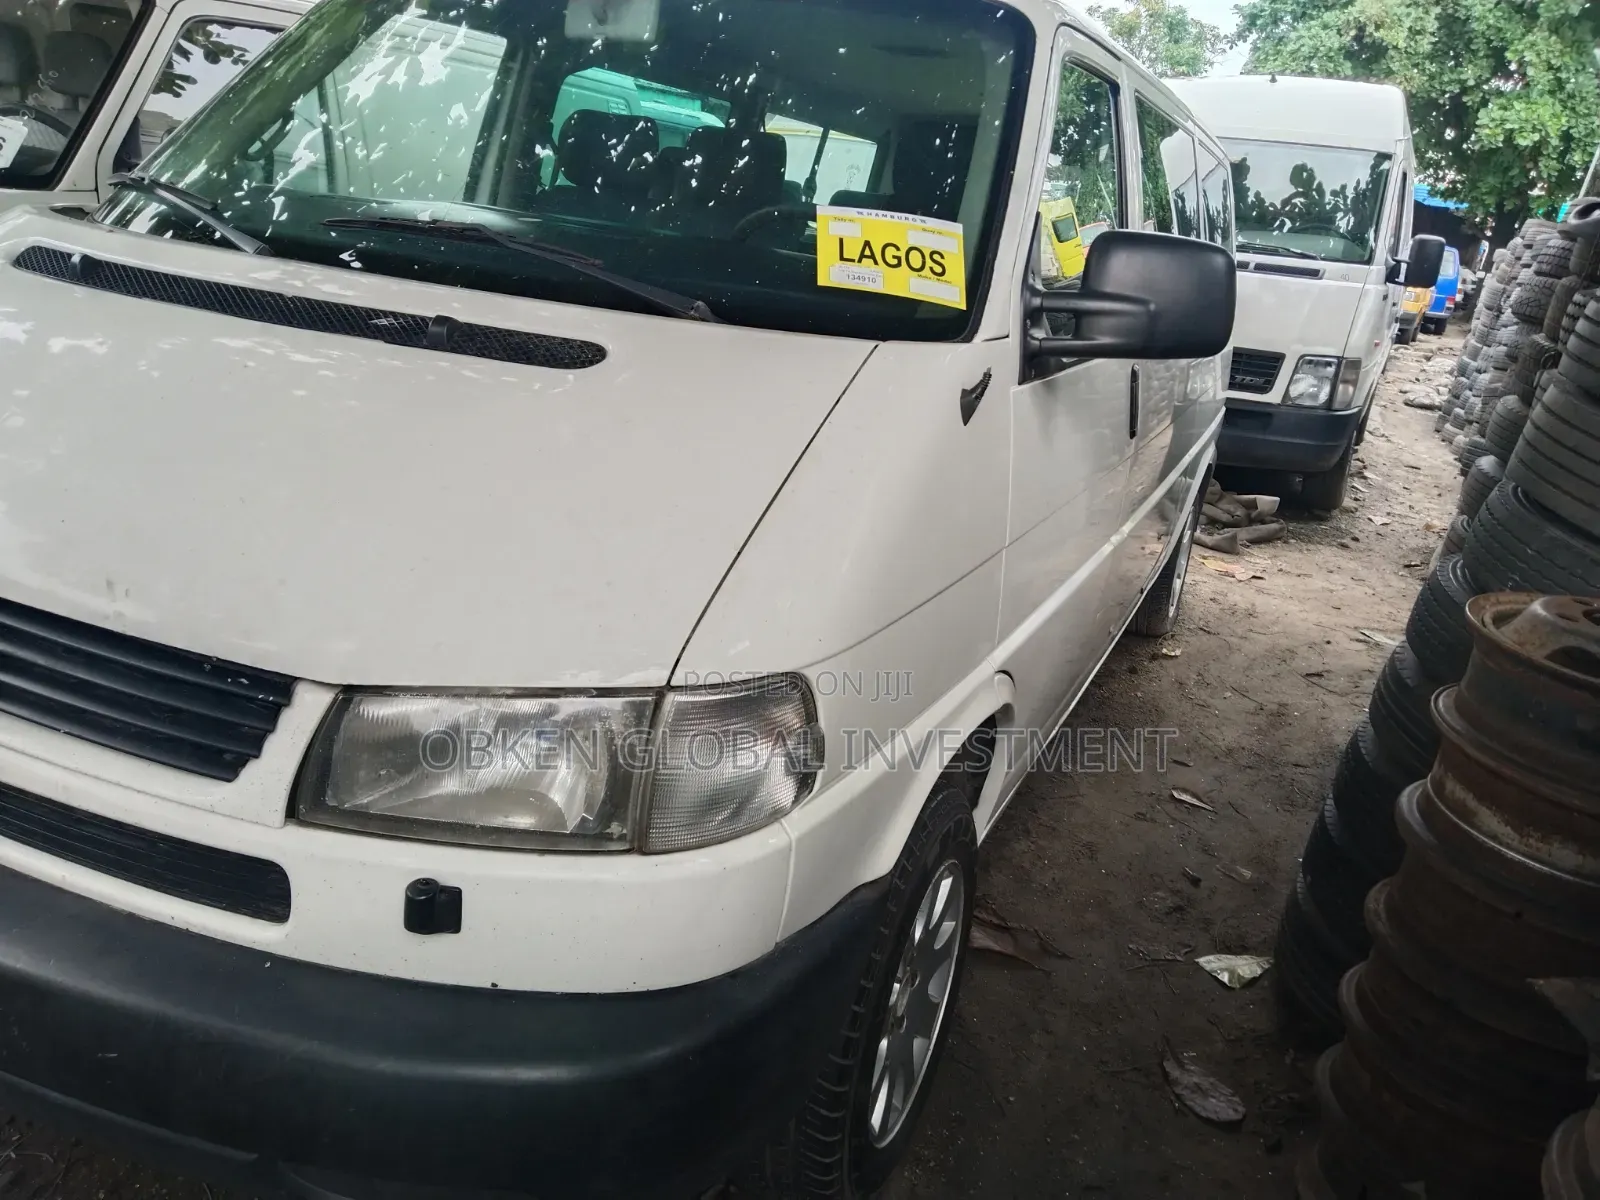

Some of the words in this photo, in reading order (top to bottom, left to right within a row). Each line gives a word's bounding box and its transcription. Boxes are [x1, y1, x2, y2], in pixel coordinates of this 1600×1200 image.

[866, 211, 917, 223] HAMBURG
[839, 237, 946, 277] LAGOS
[847, 273, 877, 284] 134910
